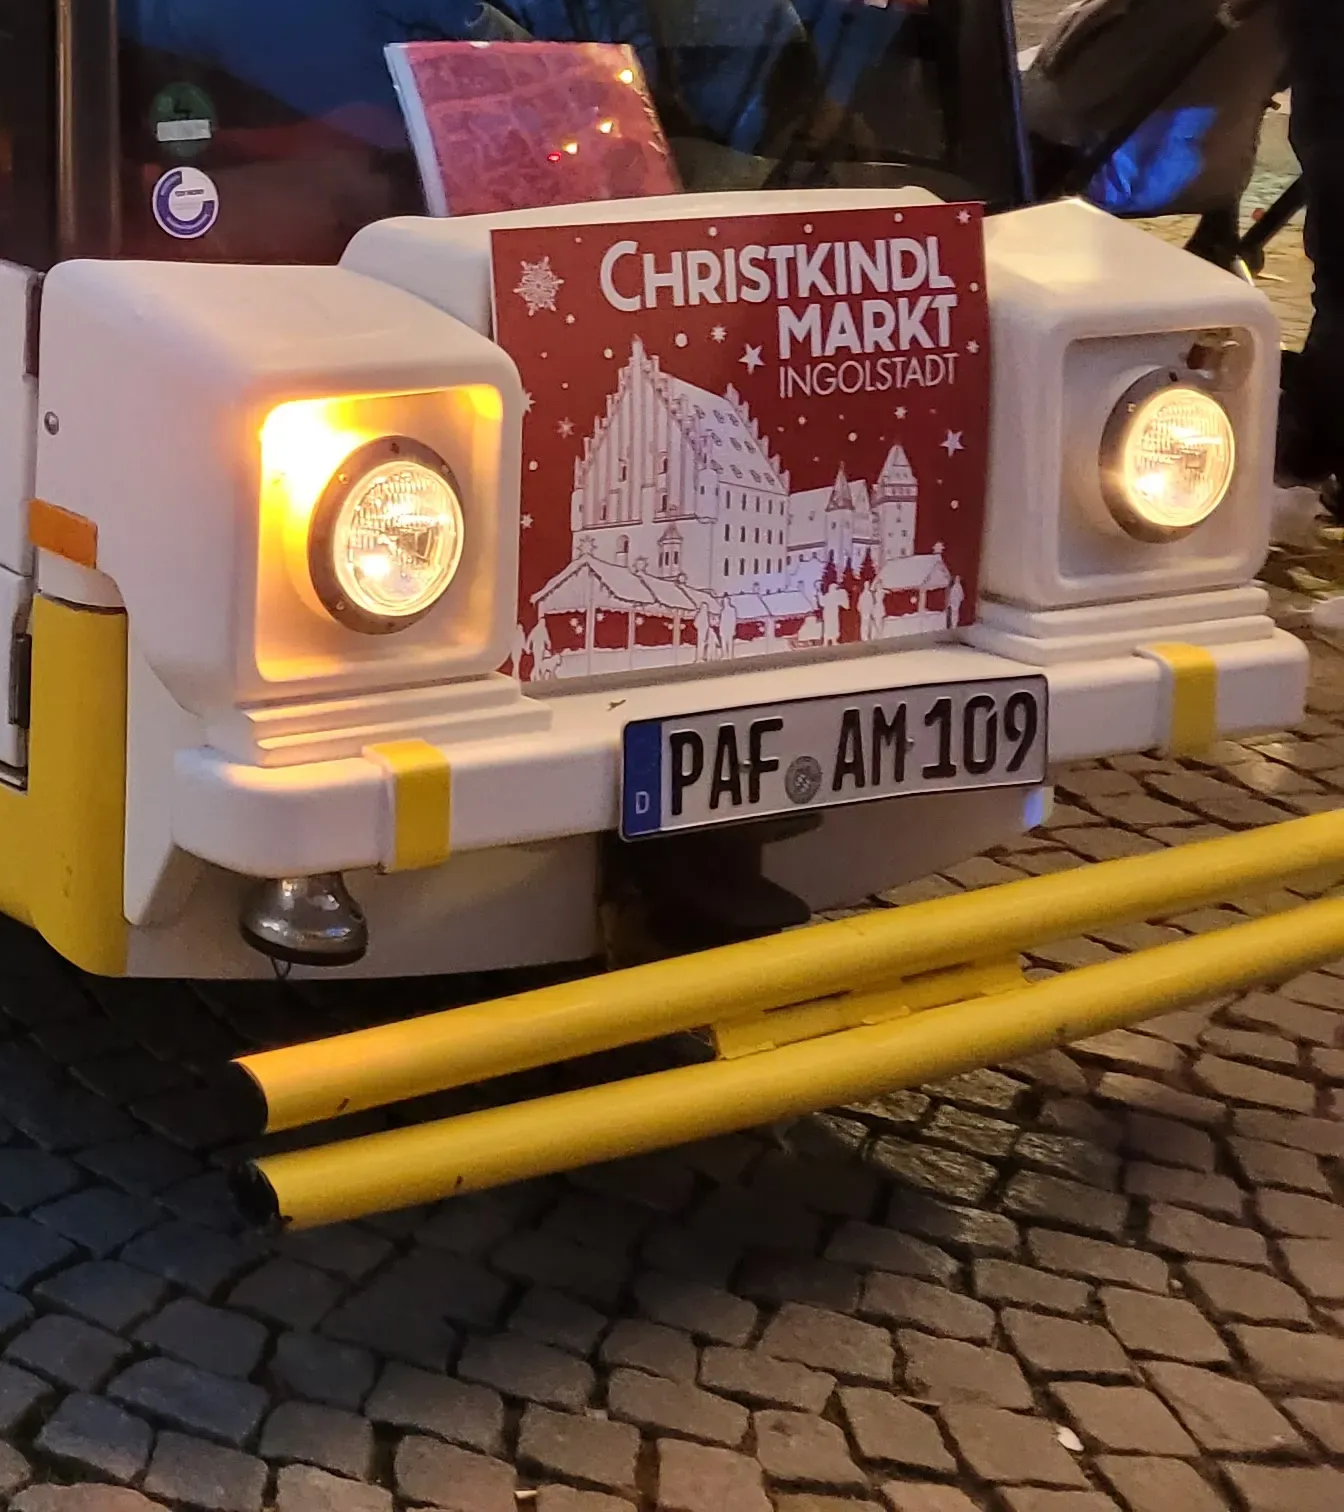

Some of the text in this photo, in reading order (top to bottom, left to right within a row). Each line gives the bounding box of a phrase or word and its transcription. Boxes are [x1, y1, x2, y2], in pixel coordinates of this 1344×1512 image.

[600, 236, 956, 312] CHRISTKINDL
[777, 294, 958, 359] MARKT
[779, 353, 960, 399] INGOLSTADT
[669, 691, 1038, 815] PAF AM 109
[635, 790, 649, 815] D
